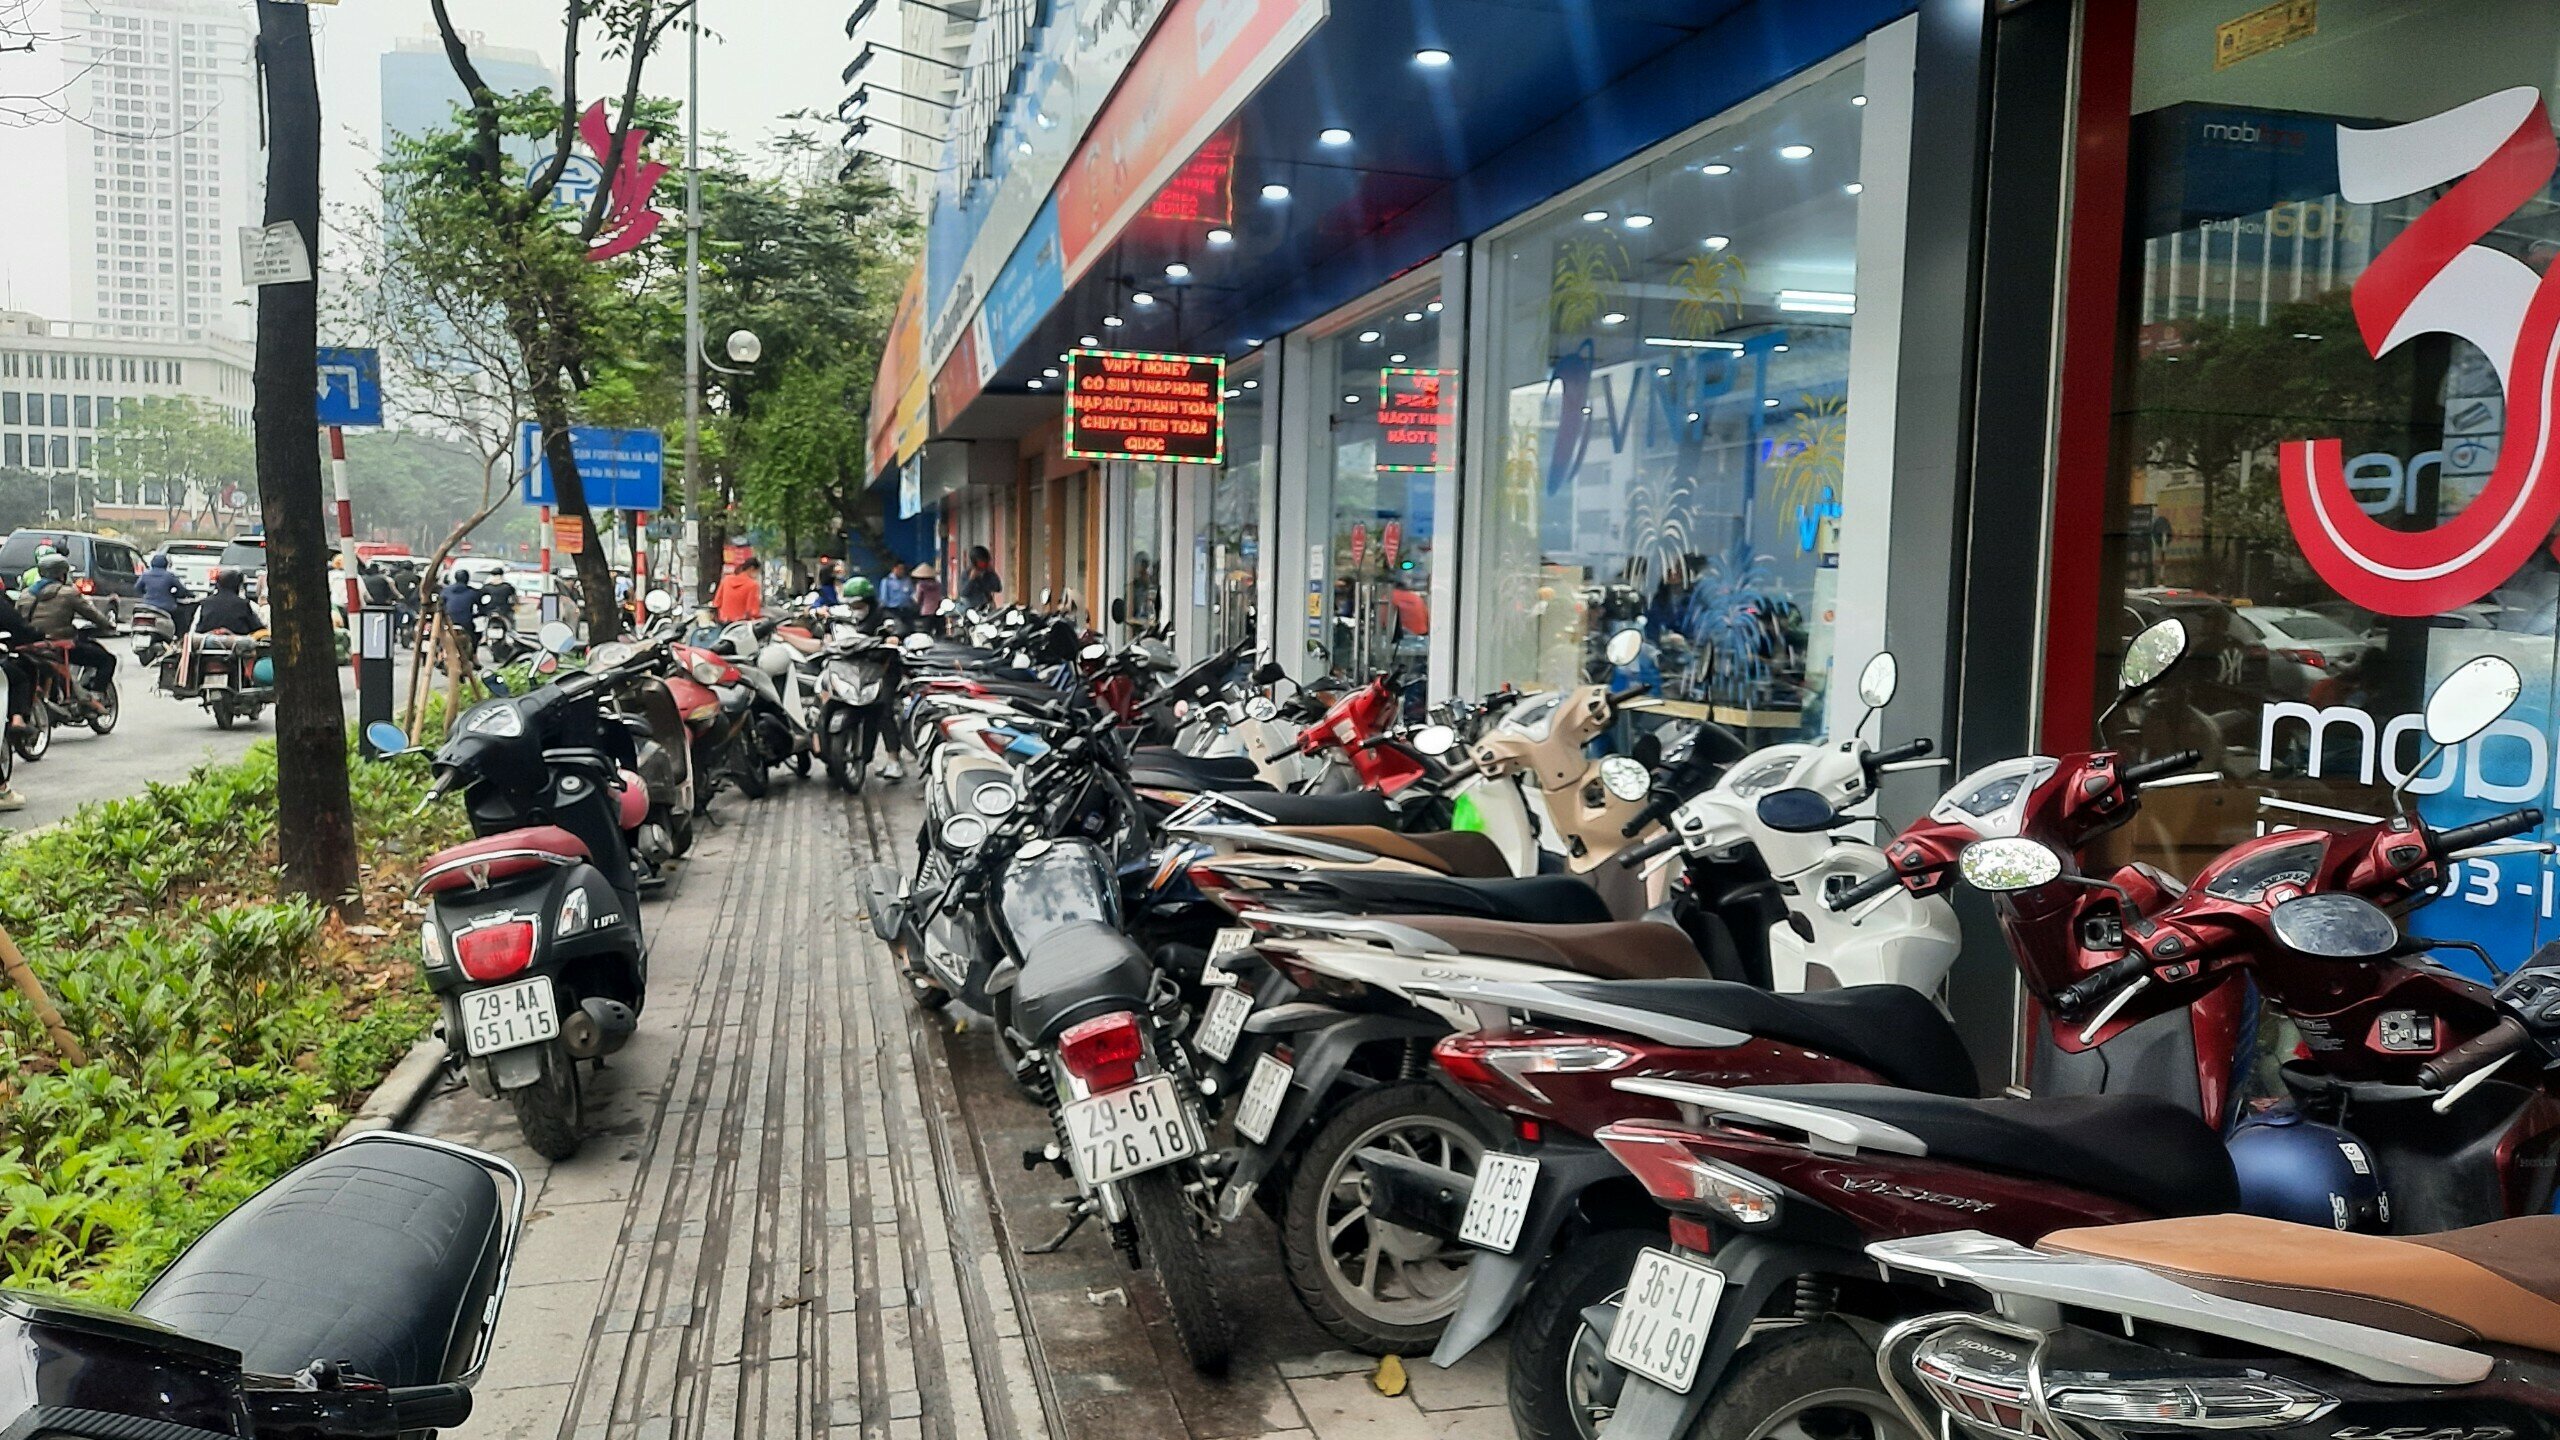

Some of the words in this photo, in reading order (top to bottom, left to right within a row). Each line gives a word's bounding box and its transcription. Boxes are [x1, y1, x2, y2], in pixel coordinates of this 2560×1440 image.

[1102, 358, 1141, 373] VNPT
[1142, 361, 1190, 376] MONEY
[1105, 377, 1130, 392] SIM
[1131, 379, 1208, 397] VINAPHONE
[1601, 330, 1788, 453] VNPT
[476, 985, 541, 1021] 29-AA
[474, 1011, 552, 1050] 651.15
[1083, 1086, 1164, 1138] 29-G1
[1084, 1121, 1184, 1179] 726.18
[1638, 1261, 1706, 1324] 36-L1
[1617, 1310, 1696, 1381] 144.99
[1955, 1338, 2019, 1363] HONDA
